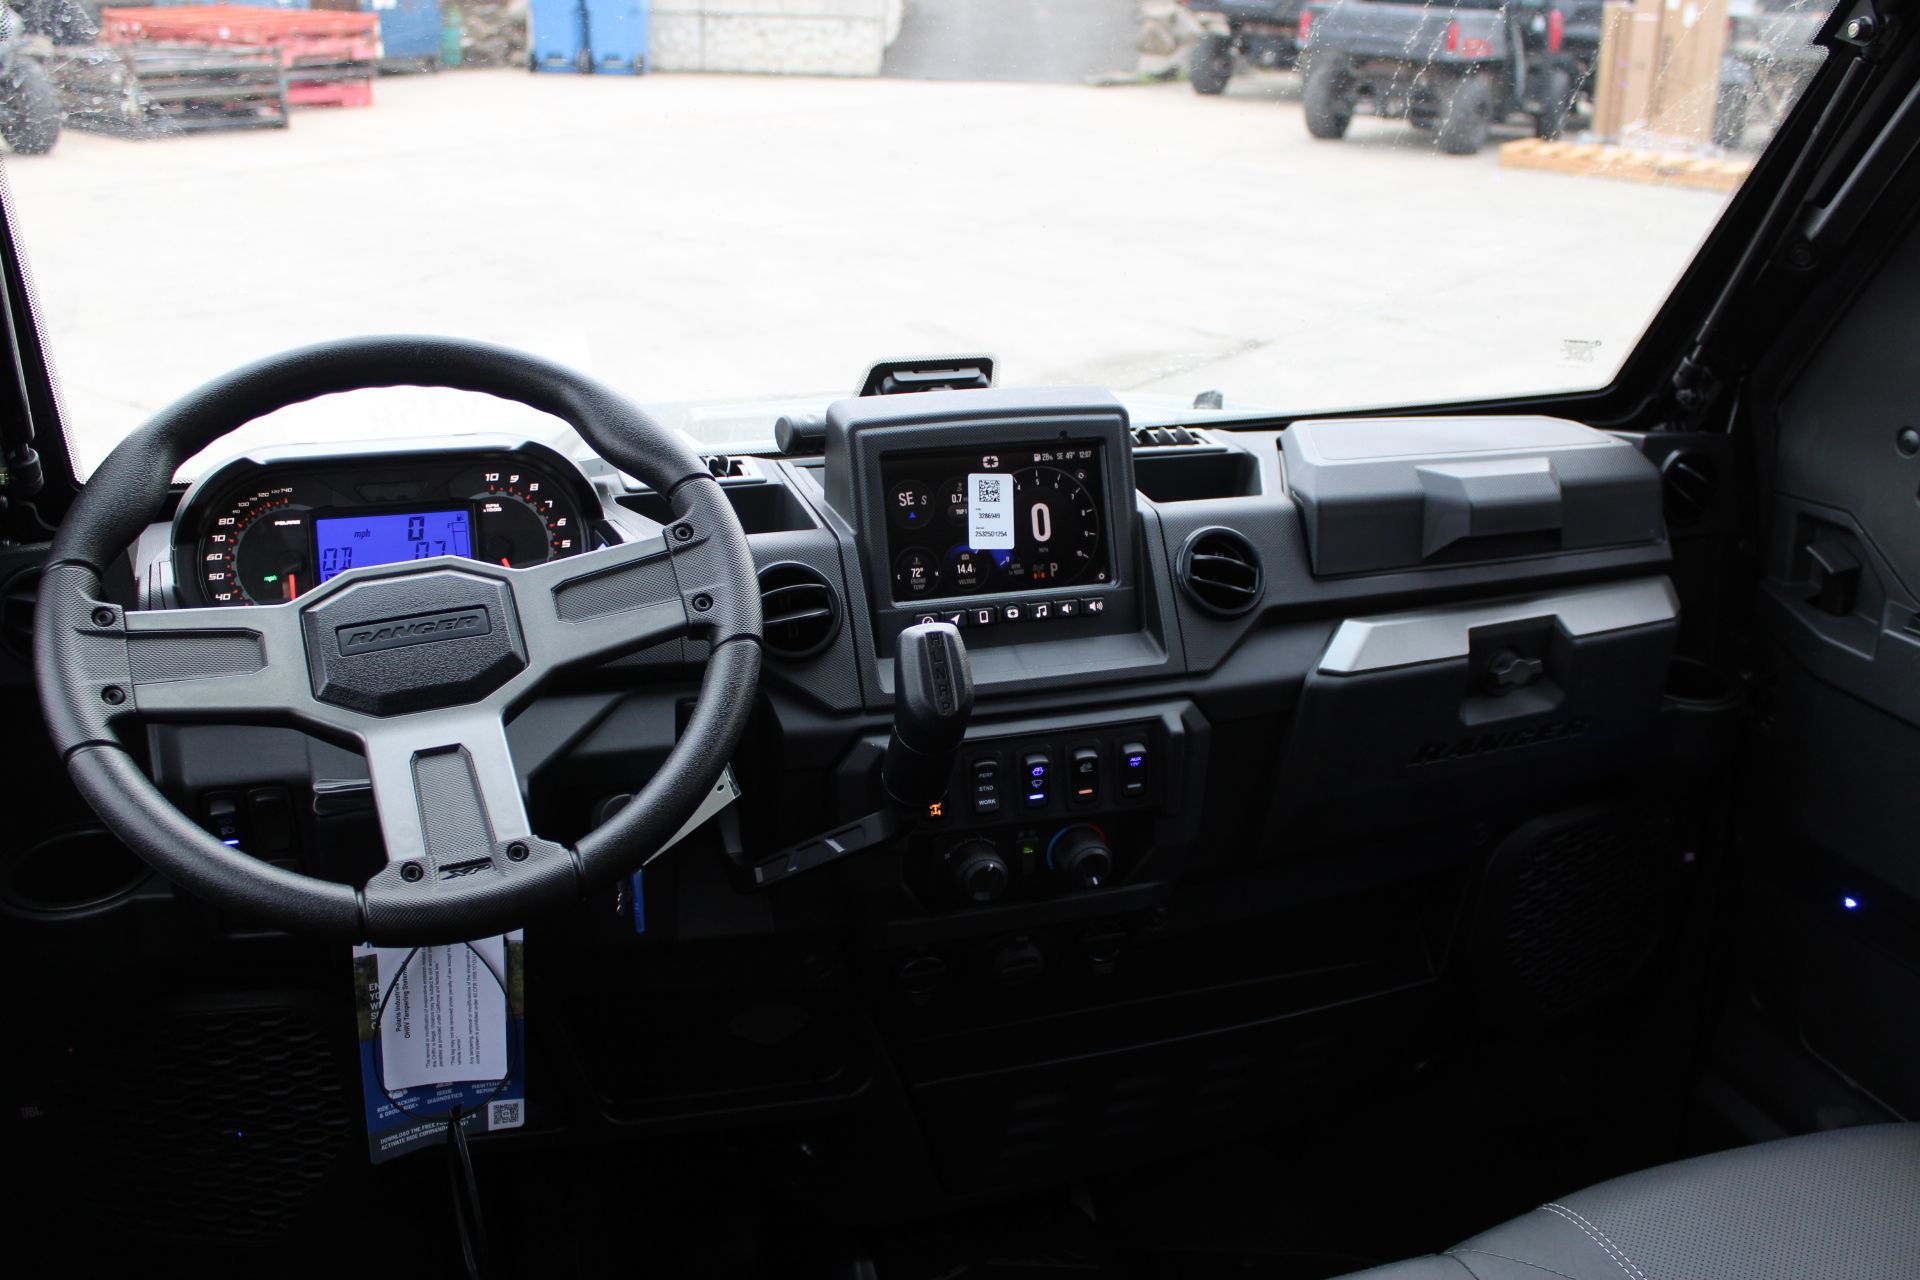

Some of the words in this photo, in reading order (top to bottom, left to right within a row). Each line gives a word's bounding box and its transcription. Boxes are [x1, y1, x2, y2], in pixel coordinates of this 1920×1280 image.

[485, 473, 499, 482] 10
[510, 475, 519, 483] 9
[530, 483, 539, 491] 8
[898, 491, 915, 507] SE
[921, 495, 928, 505] S
[951, 494, 962, 504] 0.7
[545, 500, 553, 508] 7
[218, 518, 235, 526] 80
[557, 517, 567, 526] 6
[1031, 502, 1052, 542] 0
[408, 516, 424, 541] 0
[354, 528, 371, 539] mph
[561, 539, 571, 548] 5
[206, 553, 223, 561] 60
[957, 563, 973, 574] 14.4
[1050, 562, 1058, 577] P
[209, 573, 225, 581] 50
[215, 593, 231, 601] 40
[347, 615, 481, 645] RANGER
[978, 798, 996, 806] WORK
[402, 991, 410, 1021] Tampering
[380, 1130, 410, 1144] DOWNLOAD
[411, 1126, 421, 1134] THE
